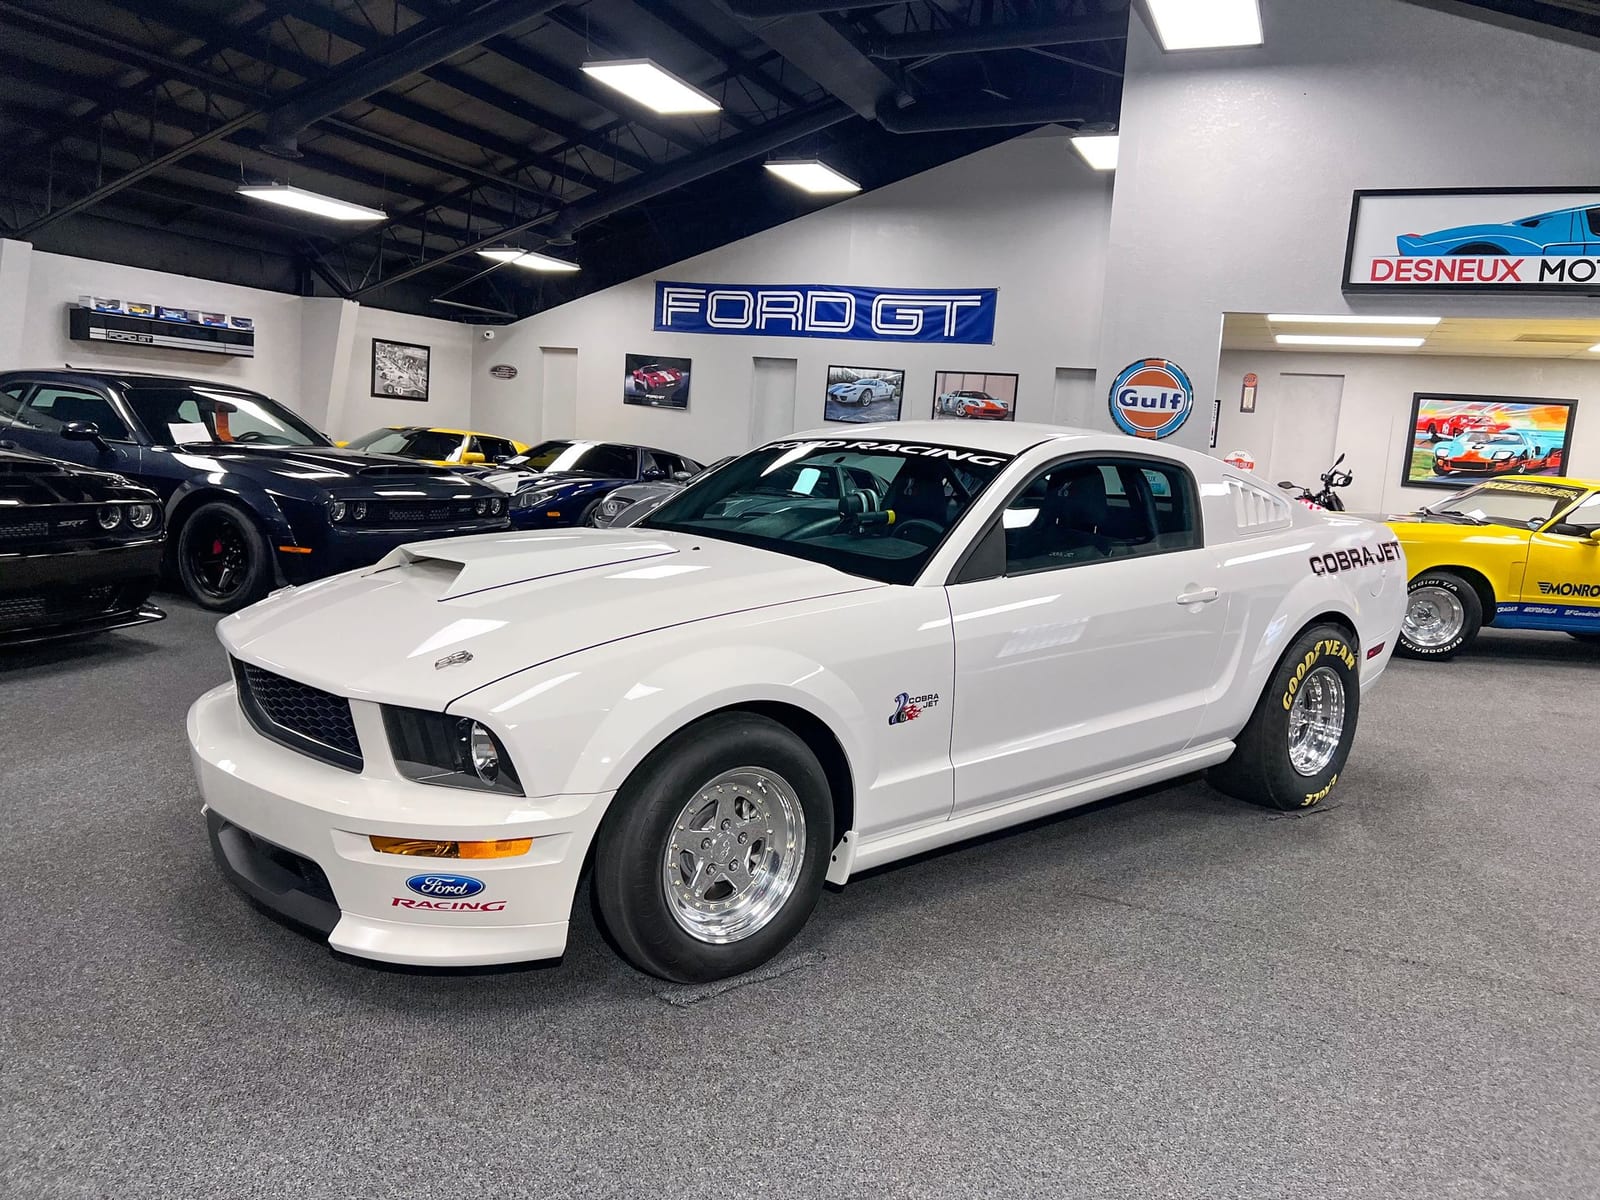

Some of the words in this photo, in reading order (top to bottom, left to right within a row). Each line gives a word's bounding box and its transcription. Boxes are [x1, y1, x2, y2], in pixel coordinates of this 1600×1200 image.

[1370, 259, 1525, 282] DESNEUX
[1538, 258, 1600, 283] MO
[663, 287, 857, 333] FORD
[871, 294, 982, 337] GT
[1119, 388, 1183, 409] Gulf
[844, 441, 1008, 467] RACING
[1310, 546, 1376, 576] COBRA
[1376, 541, 1401, 563] JET
[909, 694, 939, 704] COBRA
[923, 700, 938, 708] JET
[421, 877, 468, 894] Ford
[392, 897, 507, 912] RACING
